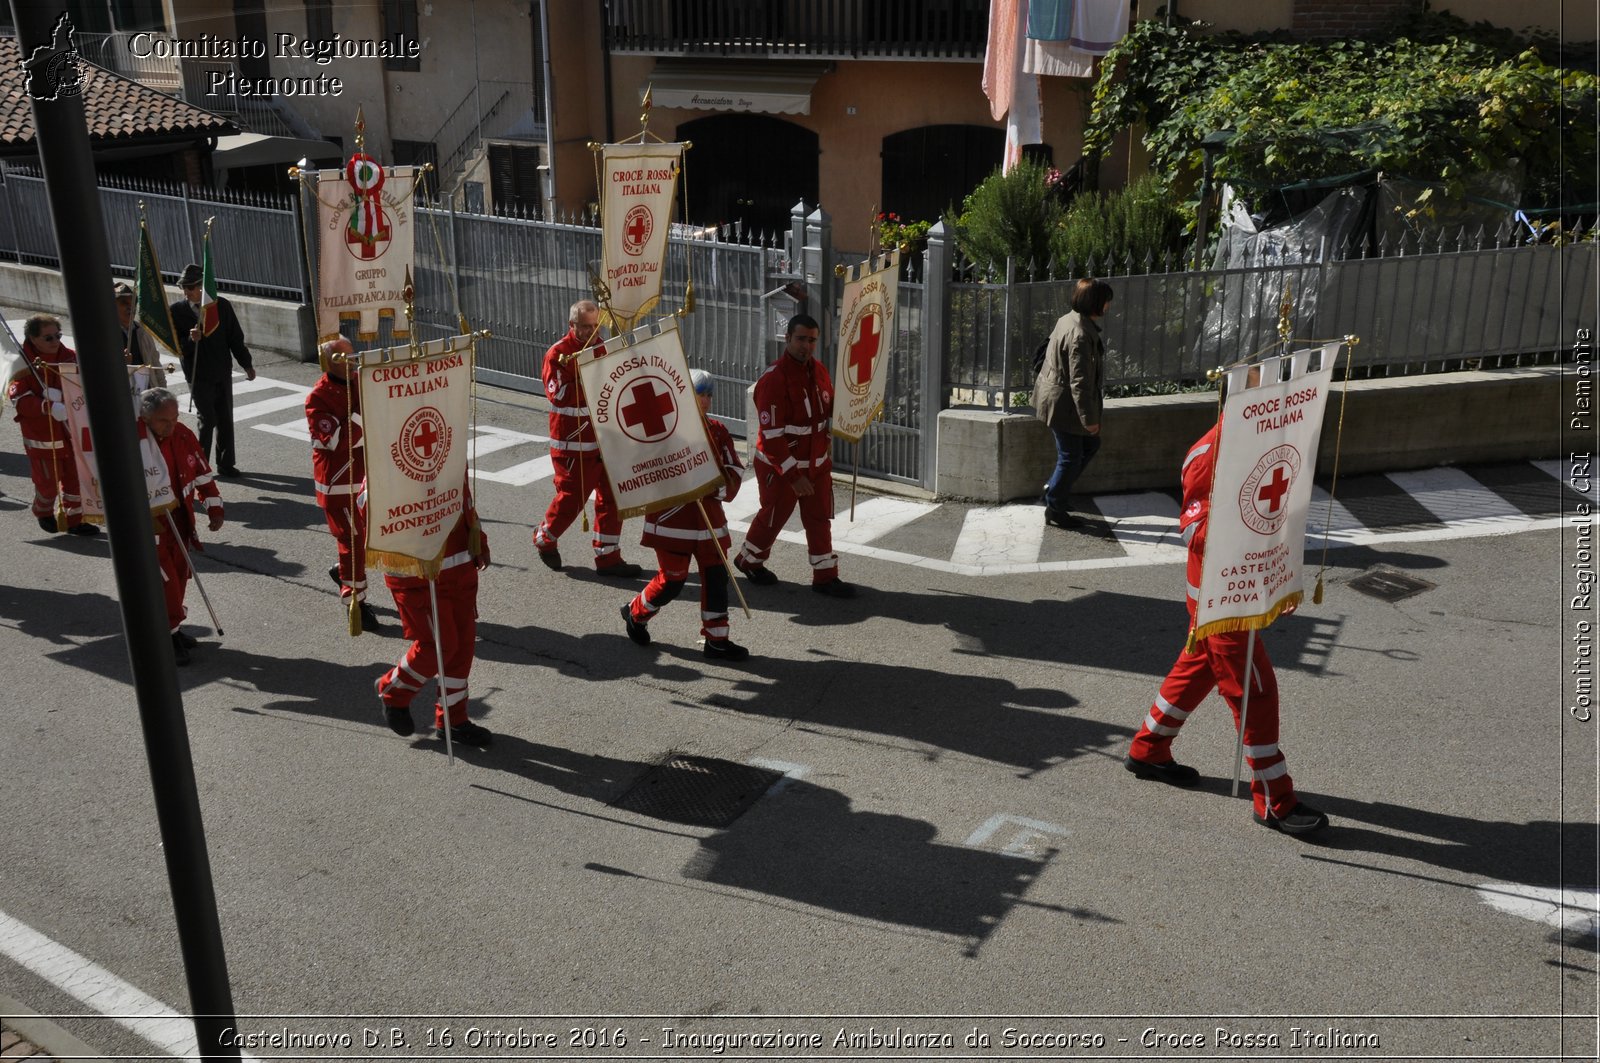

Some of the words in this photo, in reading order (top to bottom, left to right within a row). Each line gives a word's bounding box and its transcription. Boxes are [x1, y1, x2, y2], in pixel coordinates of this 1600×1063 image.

[612, 170, 643, 182] CROCE
[647, 169, 672, 181] ROSSA
[622, 183, 661, 196] ITALIANA
[329, 198, 348, 231] CROCE
[380, 190, 408, 227] TALIANA
[355, 268, 386, 280] GRUPPO
[368, 281, 376, 289] DI
[324, 290, 386, 307] VILLAFRANCA
[840, 297, 858, 337] CROCE
[859, 281, 878, 302] ROSSA
[372, 363, 419, 382] CROCE
[426, 354, 463, 374] ROSSA
[388, 376, 449, 398] ITALIANA
[596, 383, 614, 424] CROCE
[609, 355, 648, 383] ROSSA
[650, 355, 687, 394] ITALIANA
[1243, 399, 1280, 419] CROCE
[1285, 387, 1317, 408] ROSSA
[409, 420, 417, 428] DI
[1256, 408, 1303, 434] ITALIANA
[390, 441, 423, 481] VOLONTARI
[425, 471, 438, 482] DEL
[436, 426, 452, 474] SOCCORSO
[632, 458, 664, 474] COMITATO
[664, 449, 686, 464] LOCALE
[685, 446, 692, 455] DI
[618, 462, 687, 494] MONTEGROSSO
[687, 450, 709, 471] D'ASTI
[1257, 461, 1266, 474] DI
[388, 488, 459, 519] MONTIGLIO
[427, 487, 436, 497] DI
[380, 501, 461, 536] MONFERRATO
[422, 524, 441, 536] ASTI
[1228, 579, 1255, 591] DON
[1207, 599, 1213, 608] E
